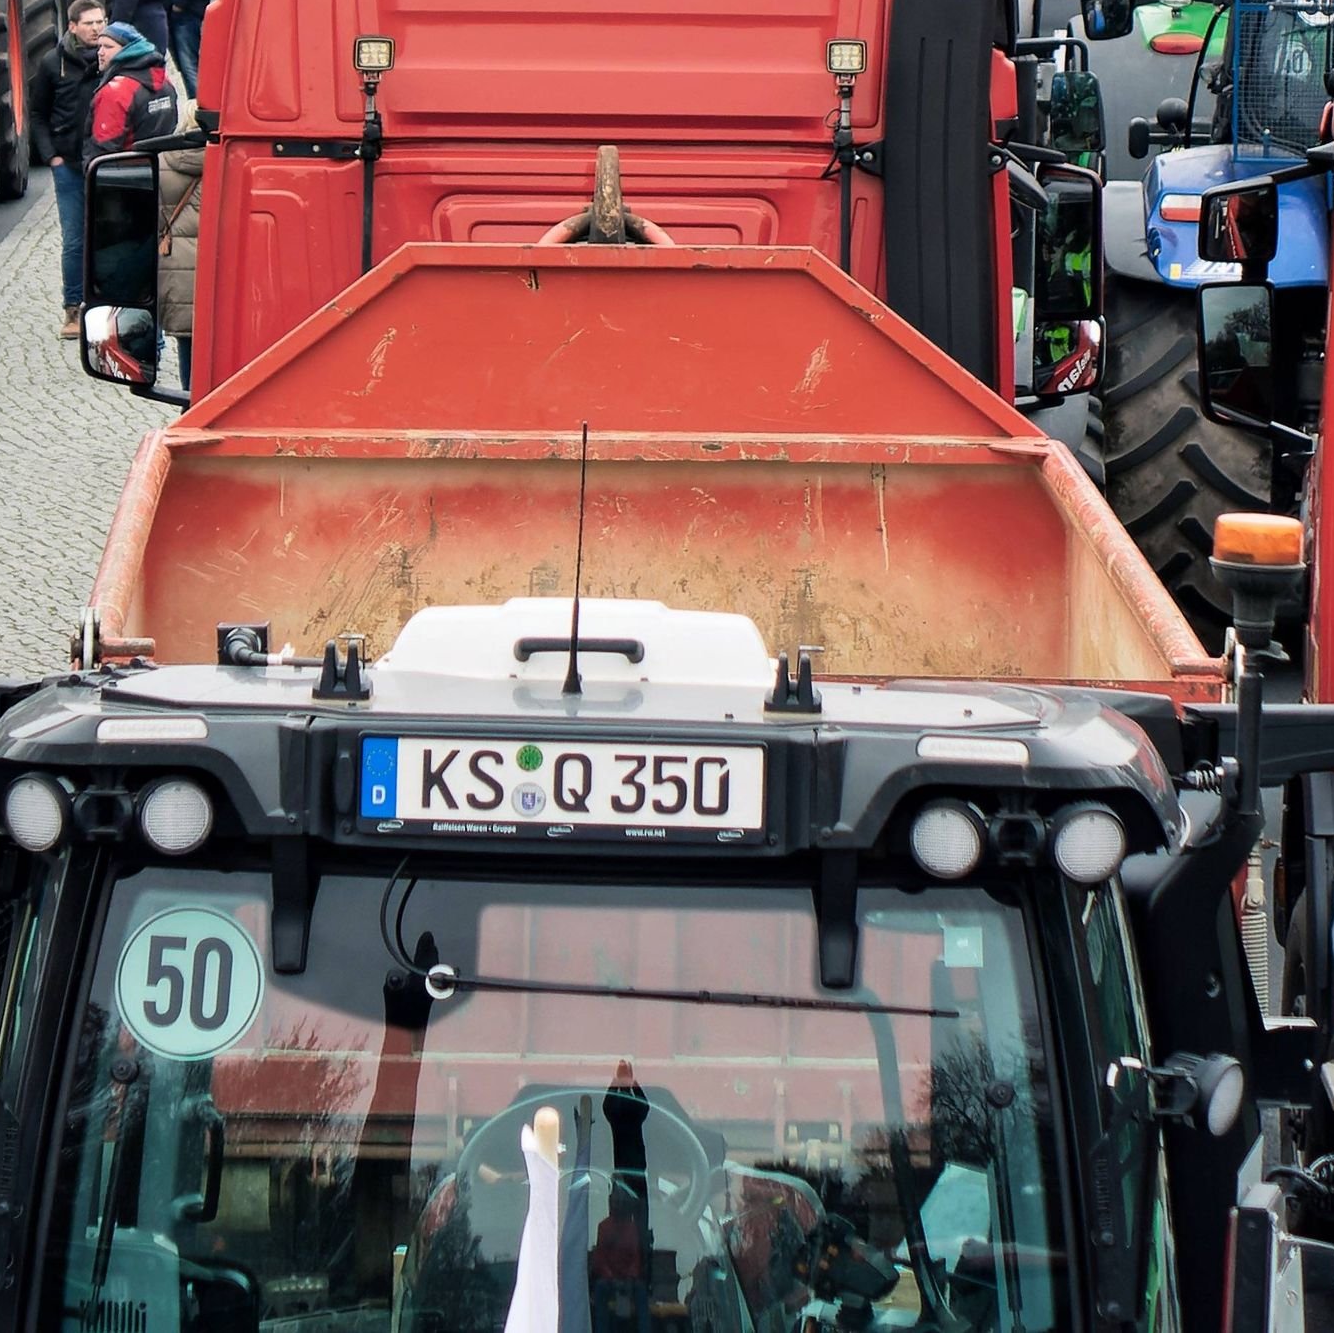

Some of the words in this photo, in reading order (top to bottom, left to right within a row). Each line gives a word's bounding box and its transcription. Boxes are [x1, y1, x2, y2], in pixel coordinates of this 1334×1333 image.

[371, 784, 387, 805] D
[421, 748, 505, 811] KS
[553, 752, 593, 813] Q
[610, 754, 730, 816] 350
[142, 934, 236, 1032] 50
